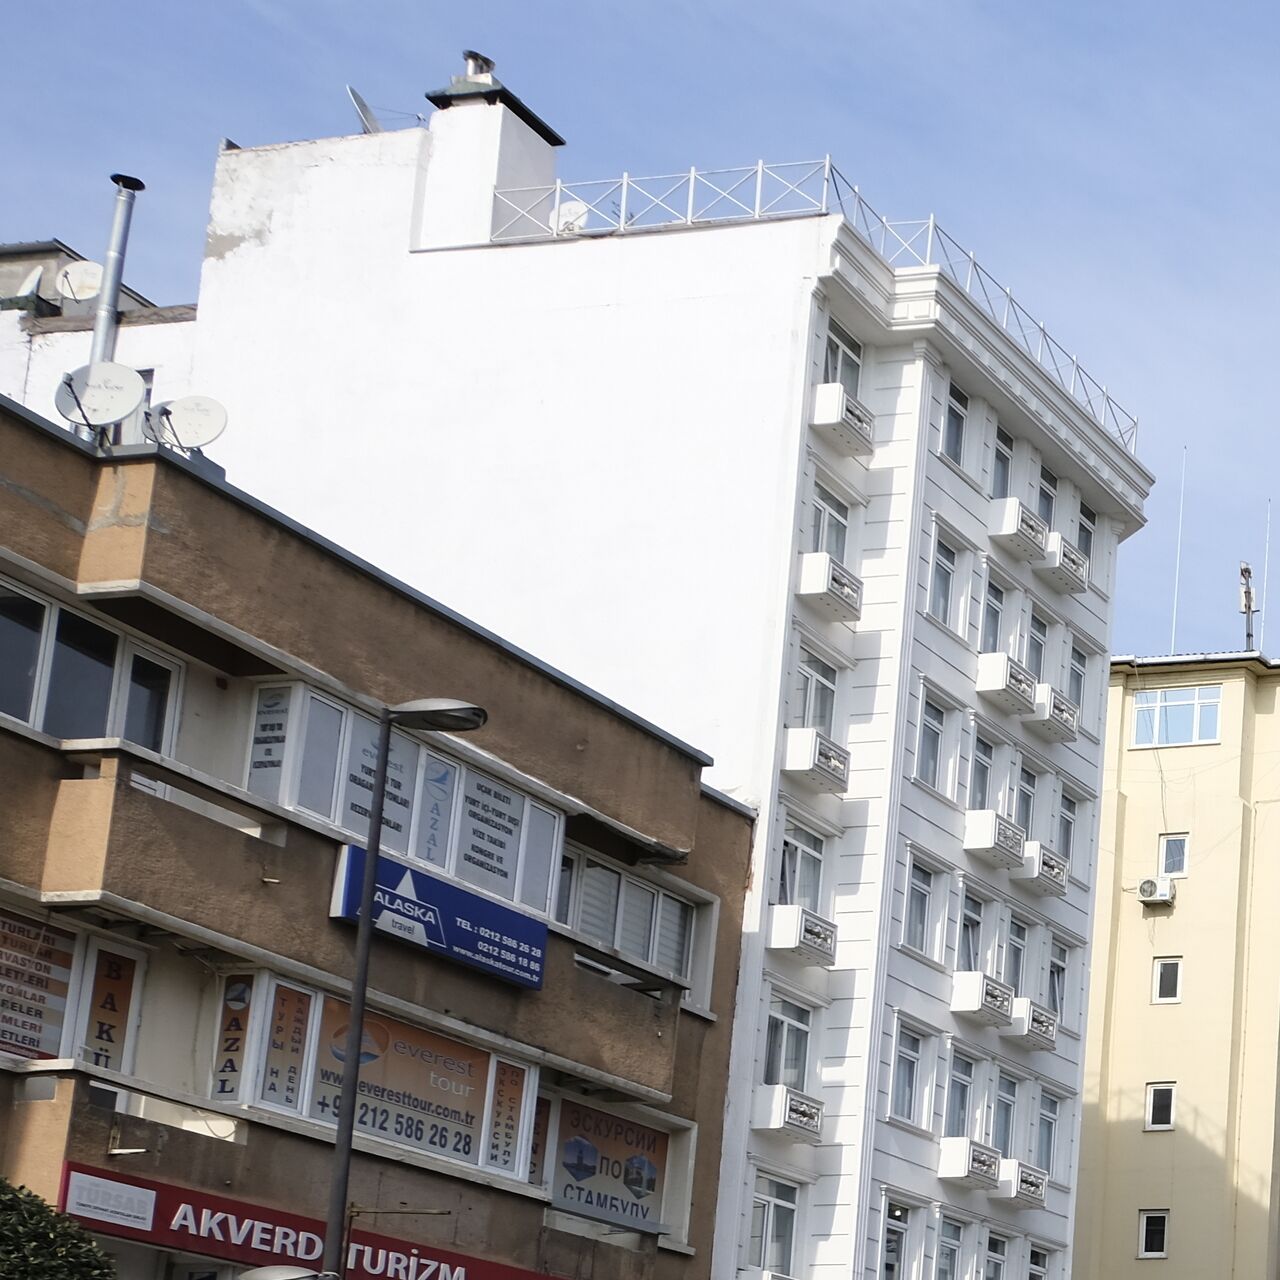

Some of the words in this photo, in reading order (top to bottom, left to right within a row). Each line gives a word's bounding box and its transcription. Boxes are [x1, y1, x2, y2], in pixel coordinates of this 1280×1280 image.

[426, 802, 441, 861] AZAL
[374, 891, 436, 925] ALASKA
[391, 918, 416, 936] travel
[455, 917, 473, 932] TEL
[479, 926, 501, 942] 0212
[477, 940, 501, 957] 0212
[217, 1016, 243, 1095] AZAL
[393, 1034, 476, 1079] everest
[319, 1066, 476, 1127] ww.everesttour.com.tr
[429, 1070, 476, 1099] tour
[357, 1102, 390, 1133] 212
[394, 1114, 425, 1143] 586
[428, 1123, 449, 1150] 26
[452, 1131, 473, 1157] 28
[599, 1156, 623, 1181] ПО
[169, 1202, 325, 1262] AKVERD
